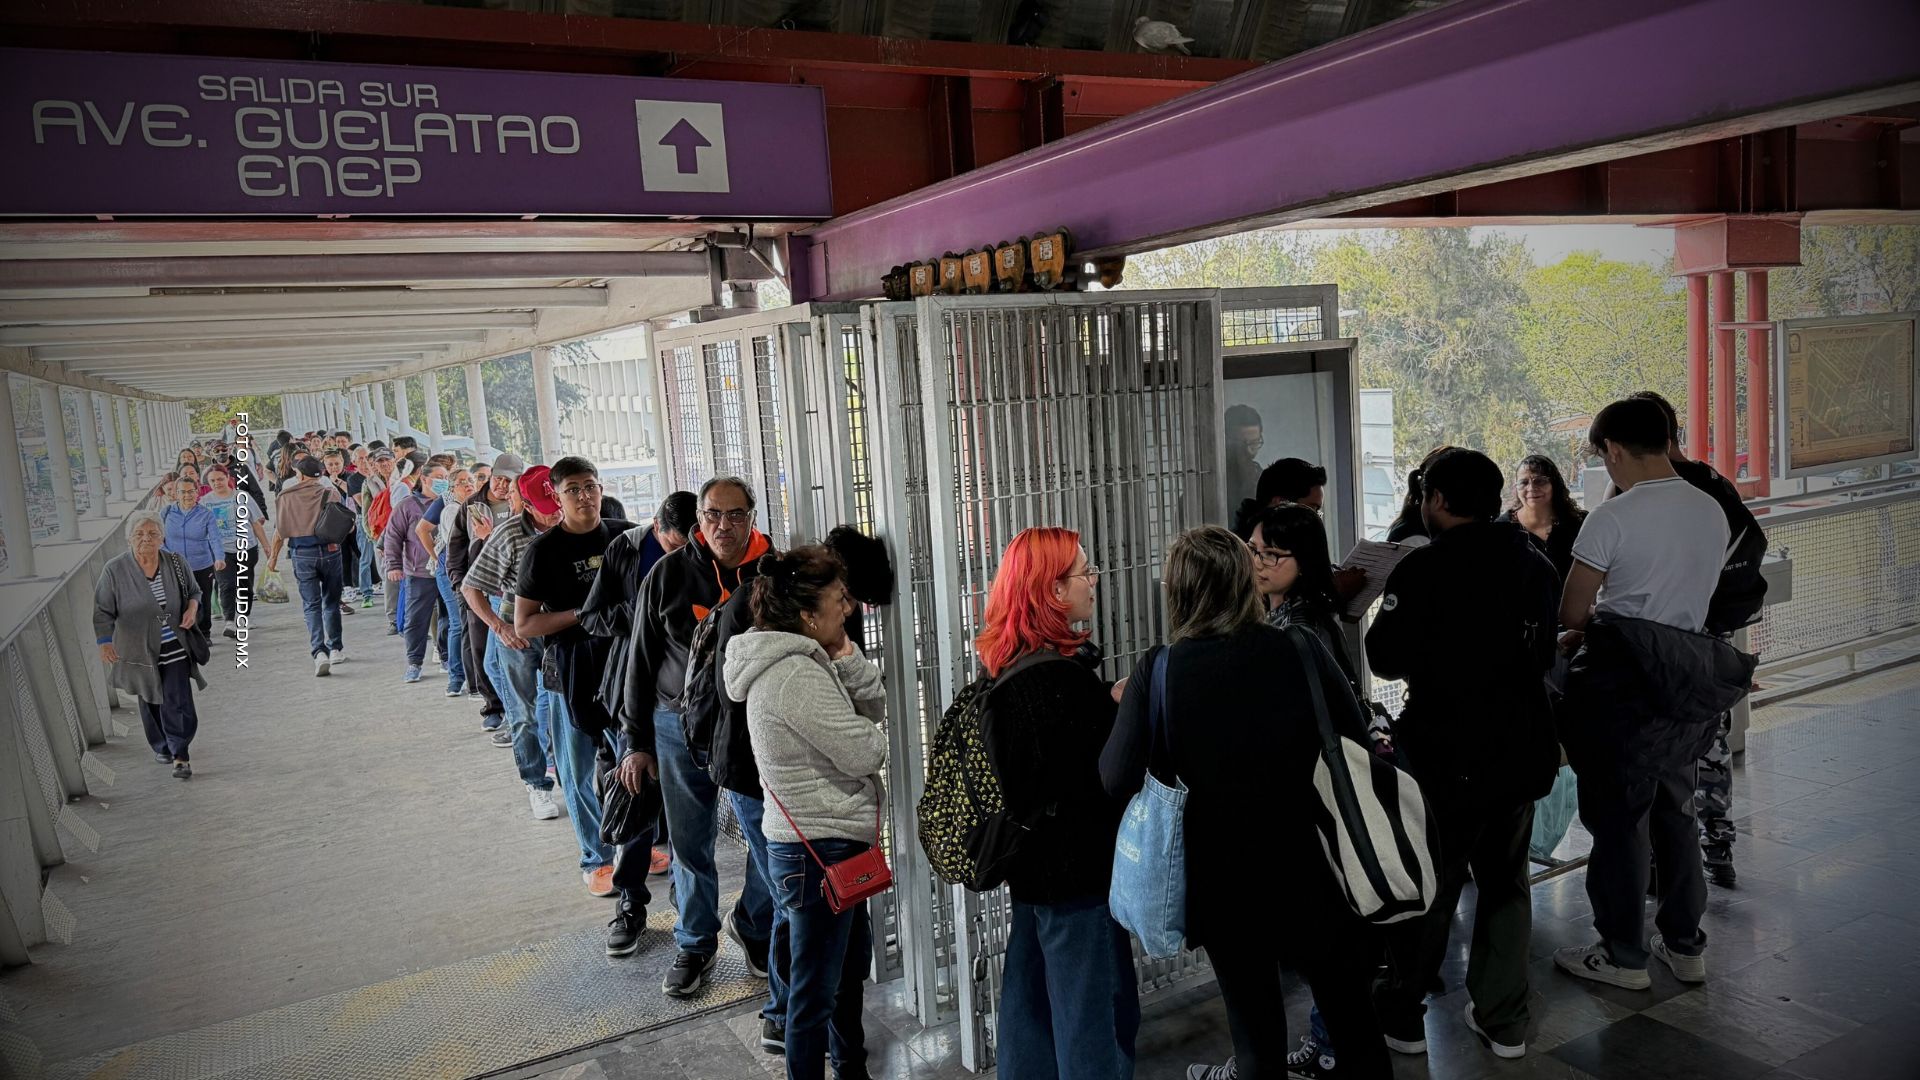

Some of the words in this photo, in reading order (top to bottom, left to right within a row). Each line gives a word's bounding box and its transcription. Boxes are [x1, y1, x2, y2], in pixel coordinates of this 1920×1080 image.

[198, 74, 345, 105] SALIDA
[359, 82, 439, 108] SUR
[32, 100, 207, 148] AVE.
[235, 107, 580, 154] GUELATAO
[237, 155, 422, 197] ENEP
